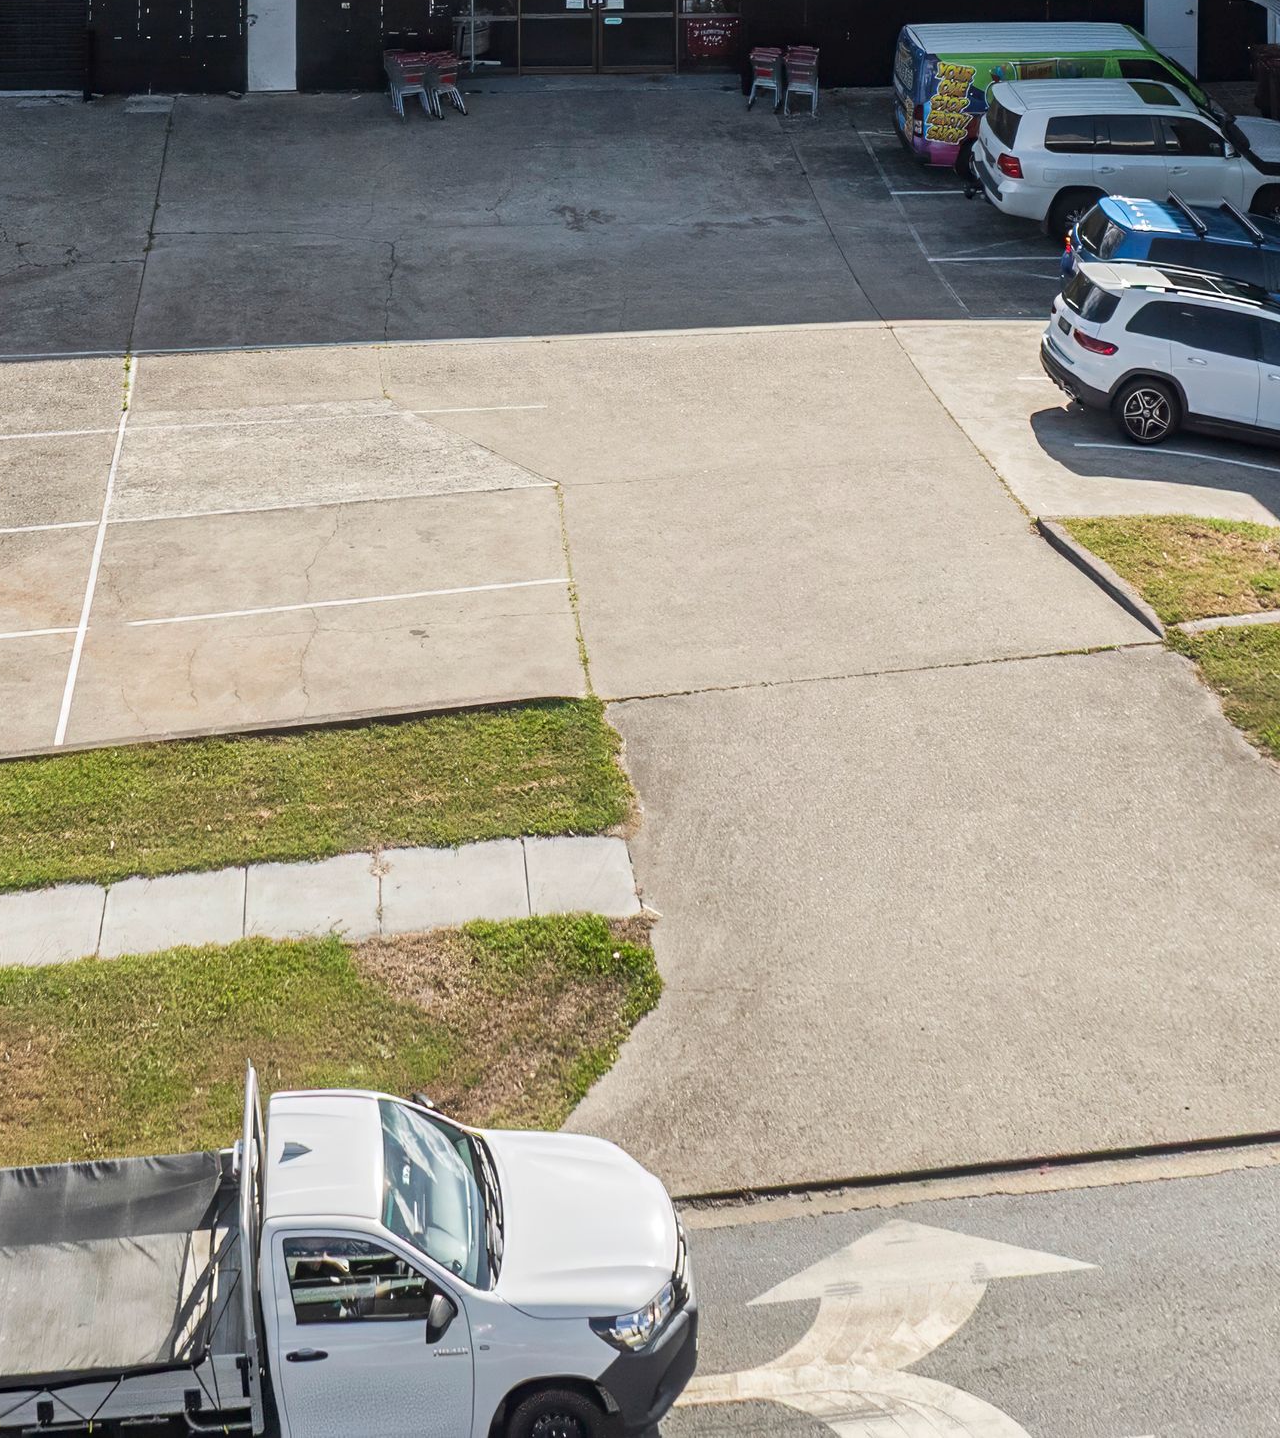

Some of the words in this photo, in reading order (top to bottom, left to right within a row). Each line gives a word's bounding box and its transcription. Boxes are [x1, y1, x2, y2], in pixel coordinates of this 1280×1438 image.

[936, 63, 976, 82] YOUR
[939, 80, 969, 97] ONE
[931, 95, 969, 112] STOP
[926, 125, 967, 143] SHOP
